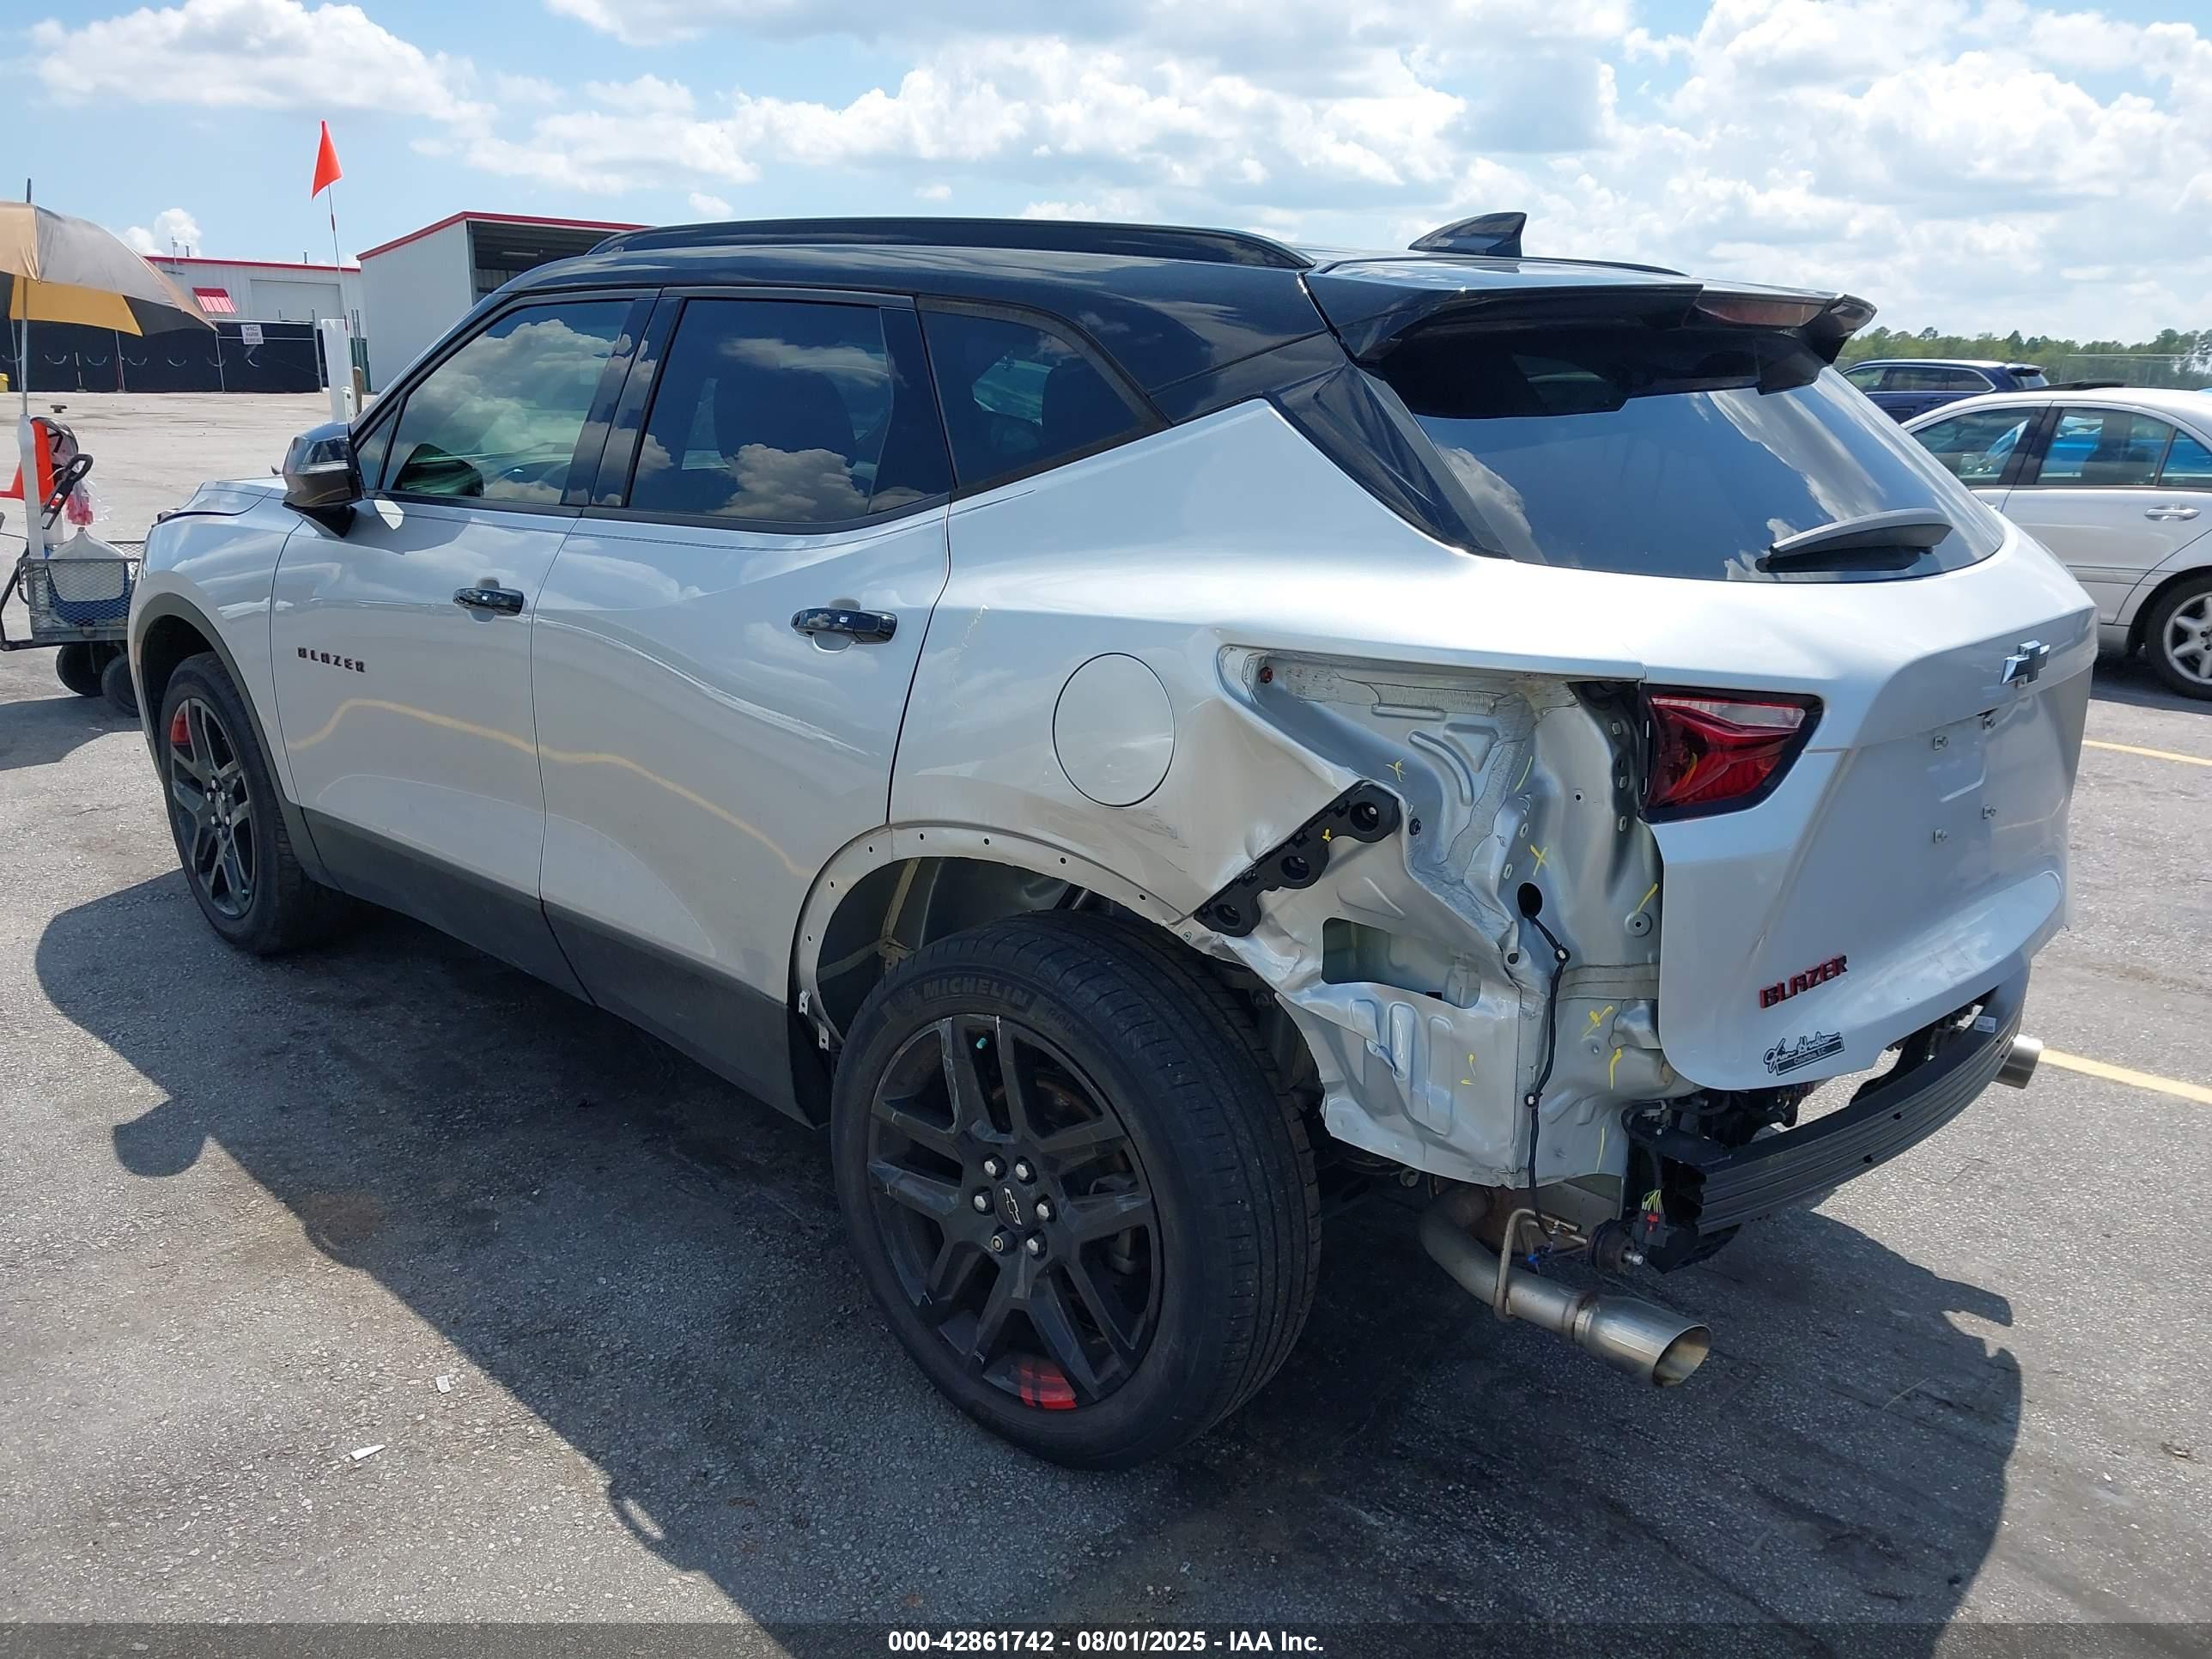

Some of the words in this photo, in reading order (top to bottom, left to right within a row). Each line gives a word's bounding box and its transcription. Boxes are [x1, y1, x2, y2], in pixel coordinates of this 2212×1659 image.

[297, 646, 365, 673] BLAZER
[922, 976, 1030, 1006] MICHELIN
[1759, 955, 1848, 1009] BLAZER
